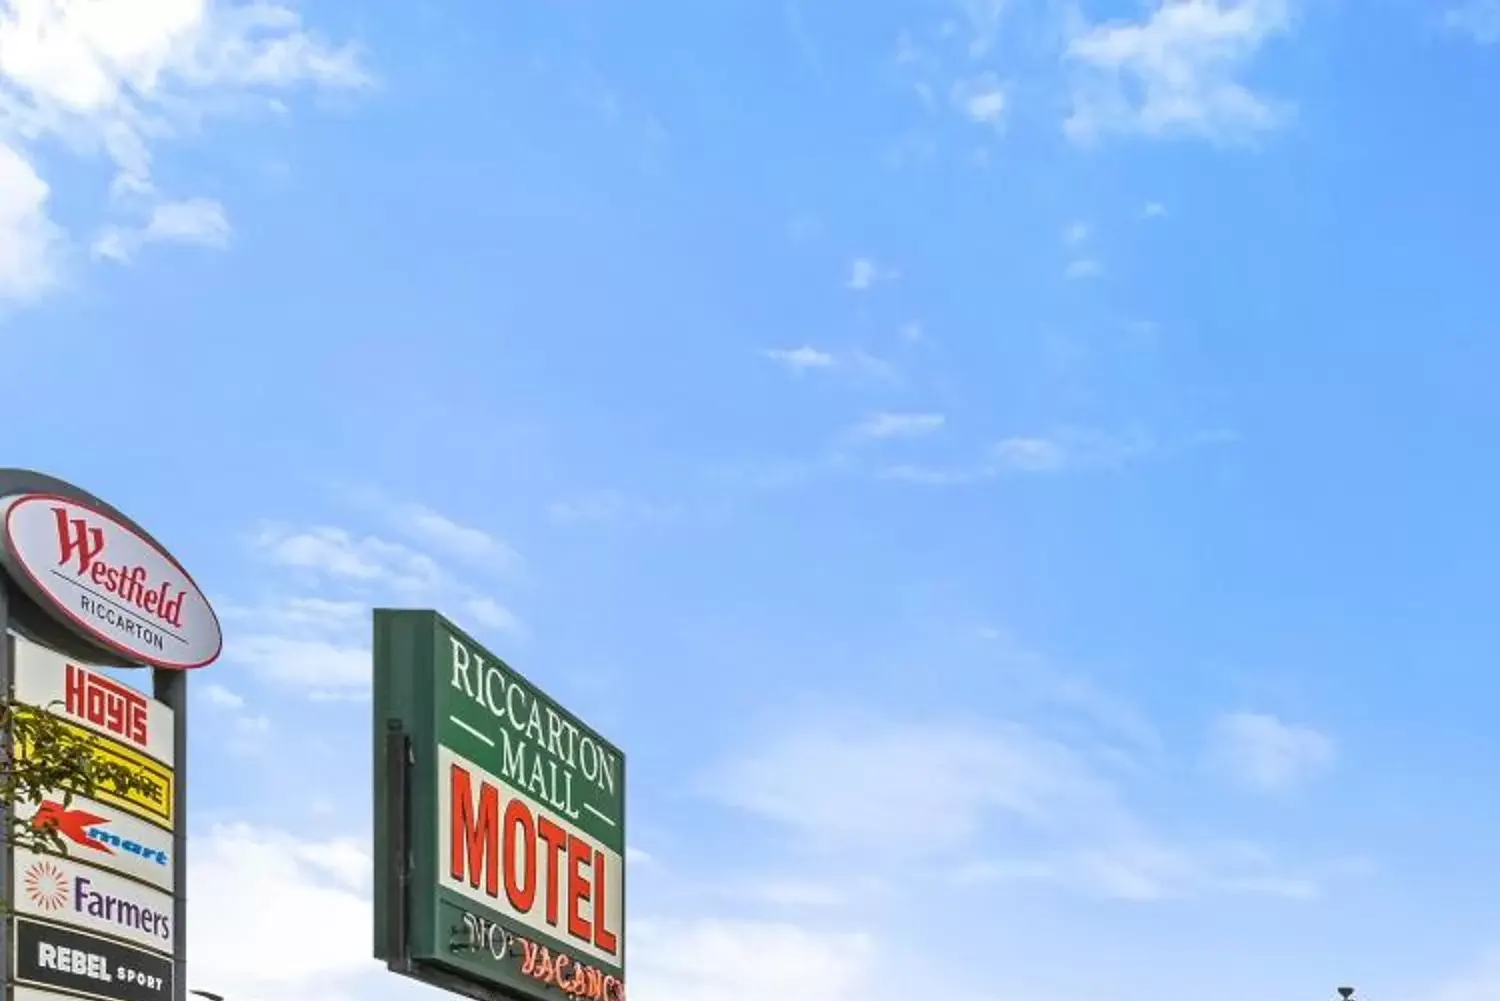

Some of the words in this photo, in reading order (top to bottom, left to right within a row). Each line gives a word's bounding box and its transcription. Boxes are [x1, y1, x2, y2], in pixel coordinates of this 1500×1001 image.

[50, 507, 188, 628] Westfield
[80, 595, 164, 651] RICCARTON
[64, 663, 148, 747] HOYTS
[449, 636, 615, 796] RICCARTON
[499, 727, 579, 820] MALL
[451, 763, 617, 956] MOTEL
[73, 875, 170, 940] Farmers
[37, 941, 112, 984] REBEL
[116, 966, 163, 992] SPORT
